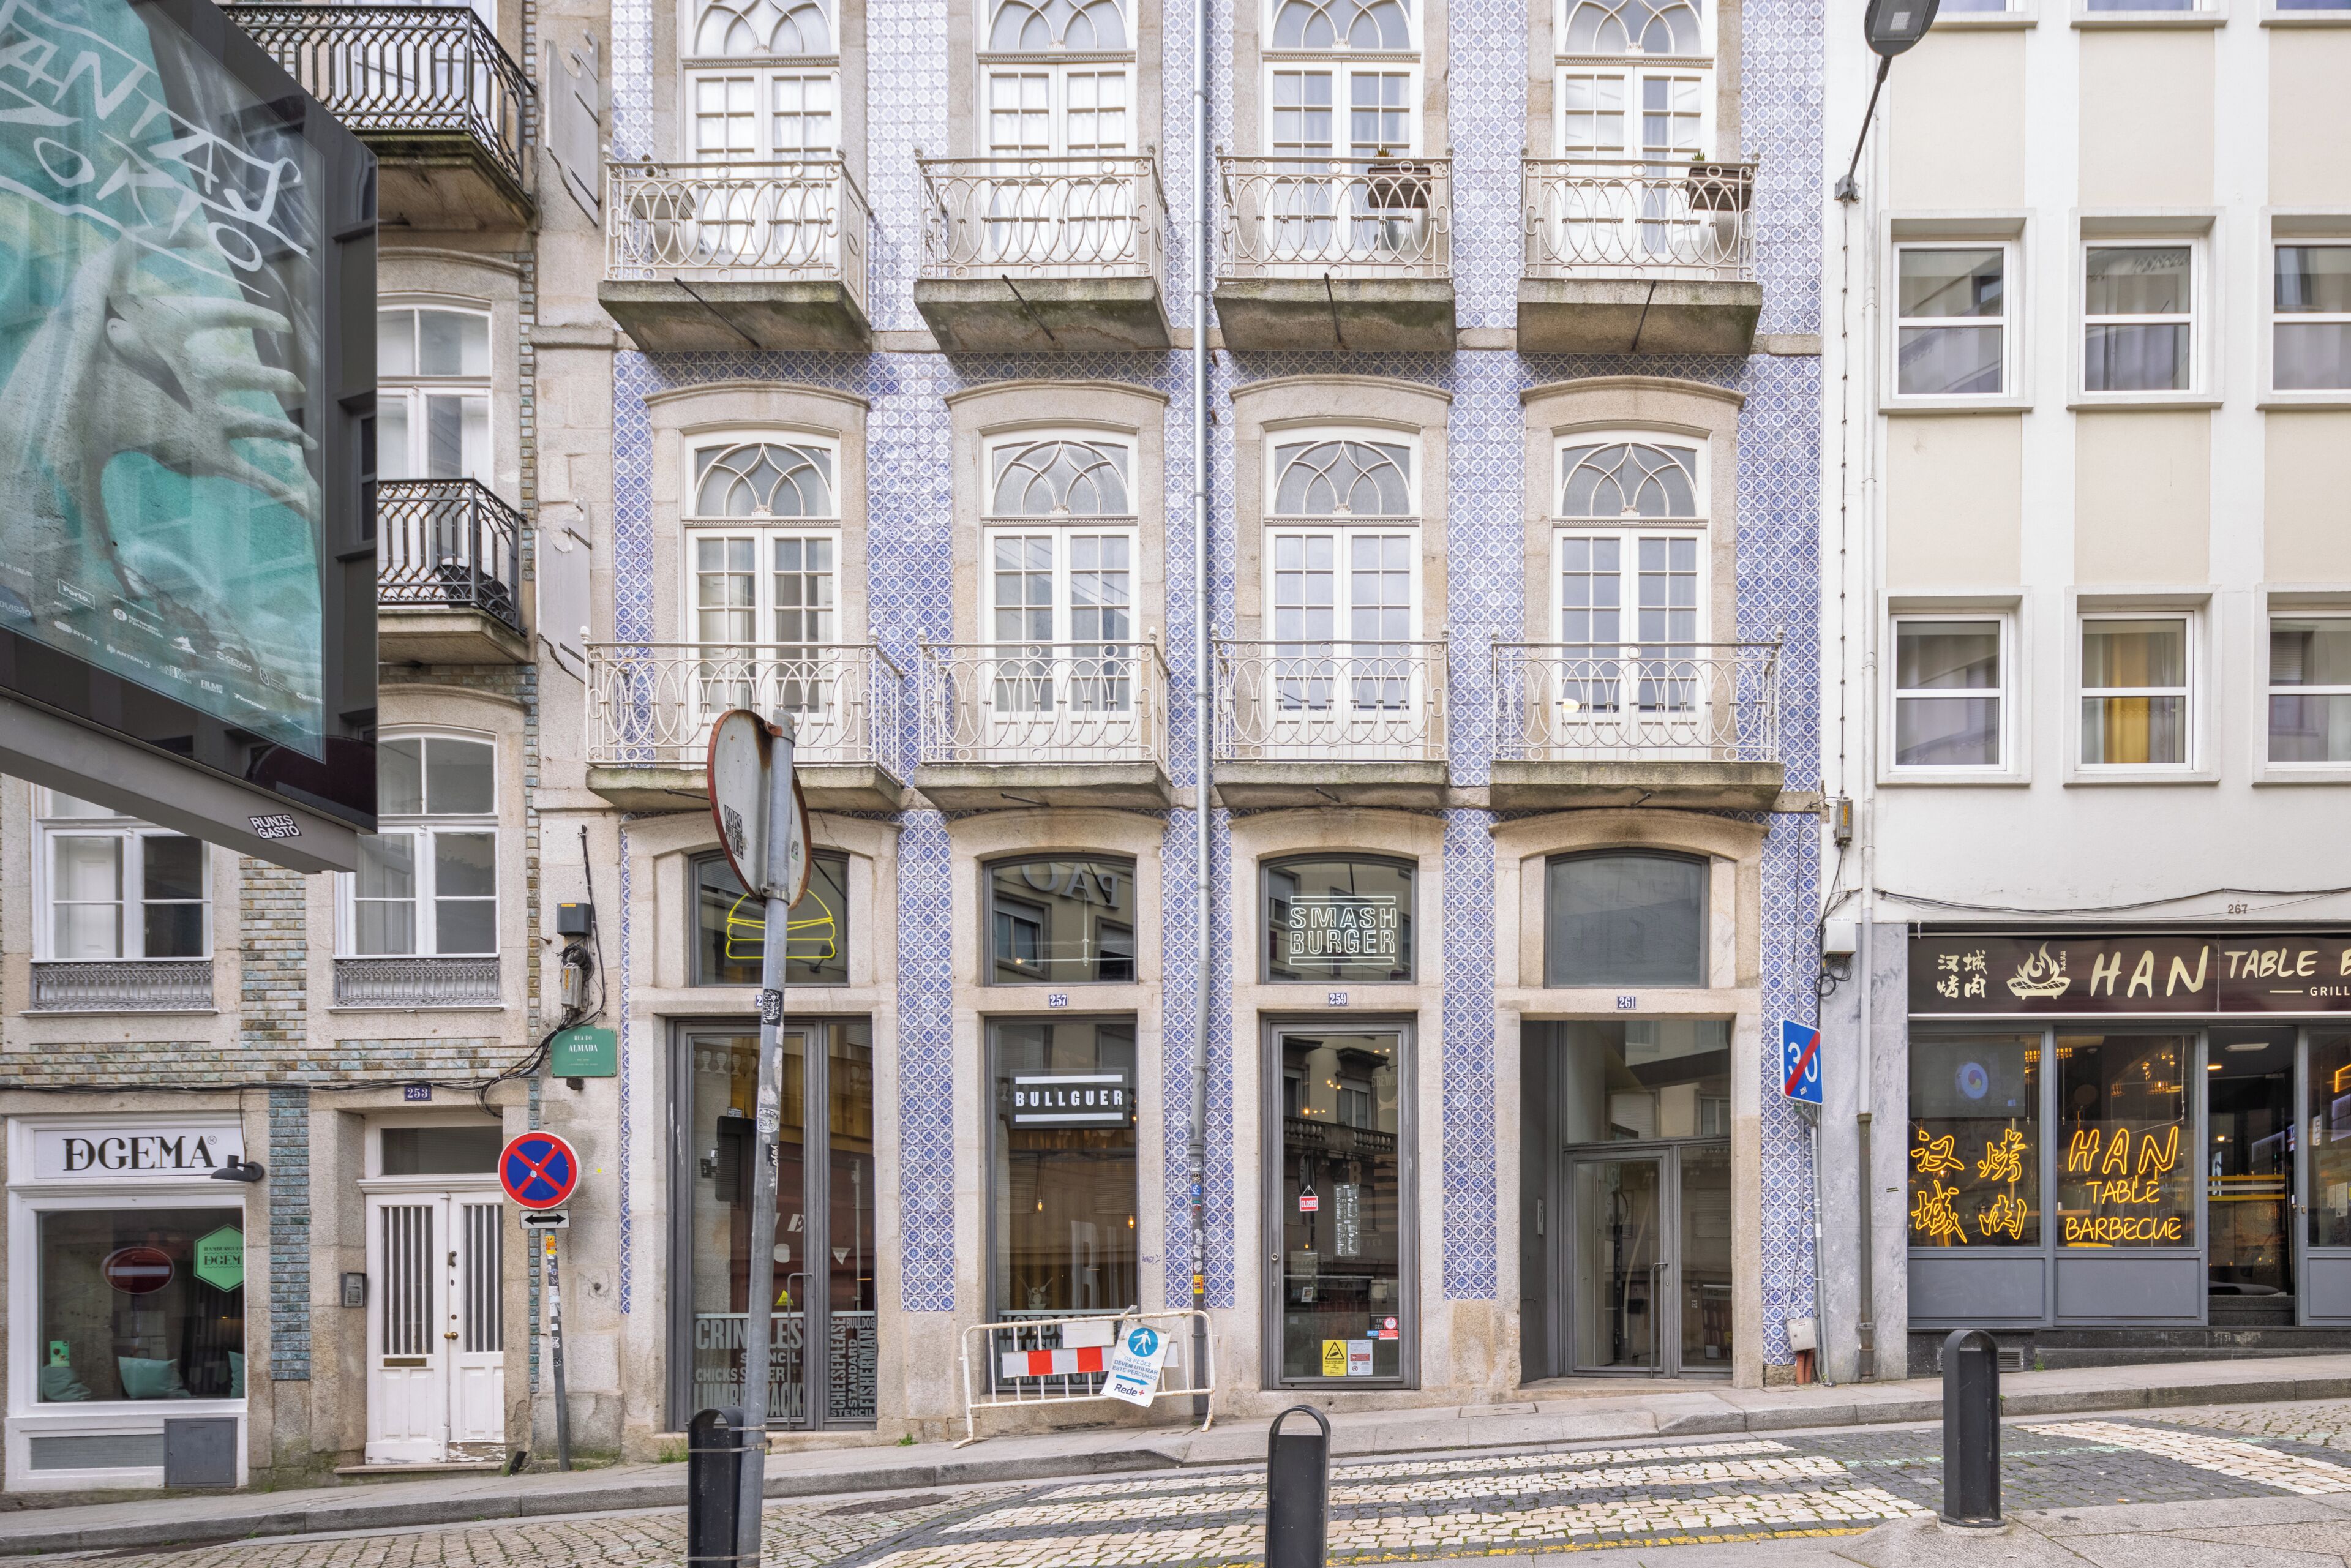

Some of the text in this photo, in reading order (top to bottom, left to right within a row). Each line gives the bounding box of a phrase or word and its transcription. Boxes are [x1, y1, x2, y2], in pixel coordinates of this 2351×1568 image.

[63, 585, 91, 603] Porto.
[54, 601, 72, 612] MEDIA
[129, 615, 159, 632] Norwegian
[116, 650, 143, 664] ANTENA
[225, 656, 252, 671] CETAPS
[250, 814, 294, 828] RUNIS
[724, 805, 743, 832] KORS
[257, 825, 300, 839] GASTO
[2227, 904, 2248, 915] 267
[1289, 907, 1397, 929] SMASH
[1290, 929, 1395, 955] BURGER
[2090, 945, 2209, 999] HAN
[2224, 948, 2319, 979] TABLE
[1049, 994, 1067, 1006] 257
[1329, 993, 1347, 1005] 259
[1619, 997, 1635, 1008] 261
[568, 1044, 598, 1052] ALMADA
[1788, 1041, 1818, 1083] 30
[407, 1087, 428, 1098] 253
[1016, 1090, 1123, 1107] BULLGUER
[2068, 1125, 2178, 1175] HAN
[2085, 1180, 2161, 1204] TABLE
[2066, 1217, 2182, 1241] BARBECUE
[846, 1317, 875, 1329] BULLDOG
[830, 1318, 846, 1408] CHEESEPLEASE
[860, 1330, 876, 1407] FISHERMAN
[1114, 1359, 1158, 1375] DEVEM UTILIZAR
[1133, 1358, 1152, 1367] PEÕES
[696, 1368, 738, 1382] CHICKS
[848, 1339, 858, 1408] STANDARD
[1127, 1369, 1157, 1381] PERCURSO
